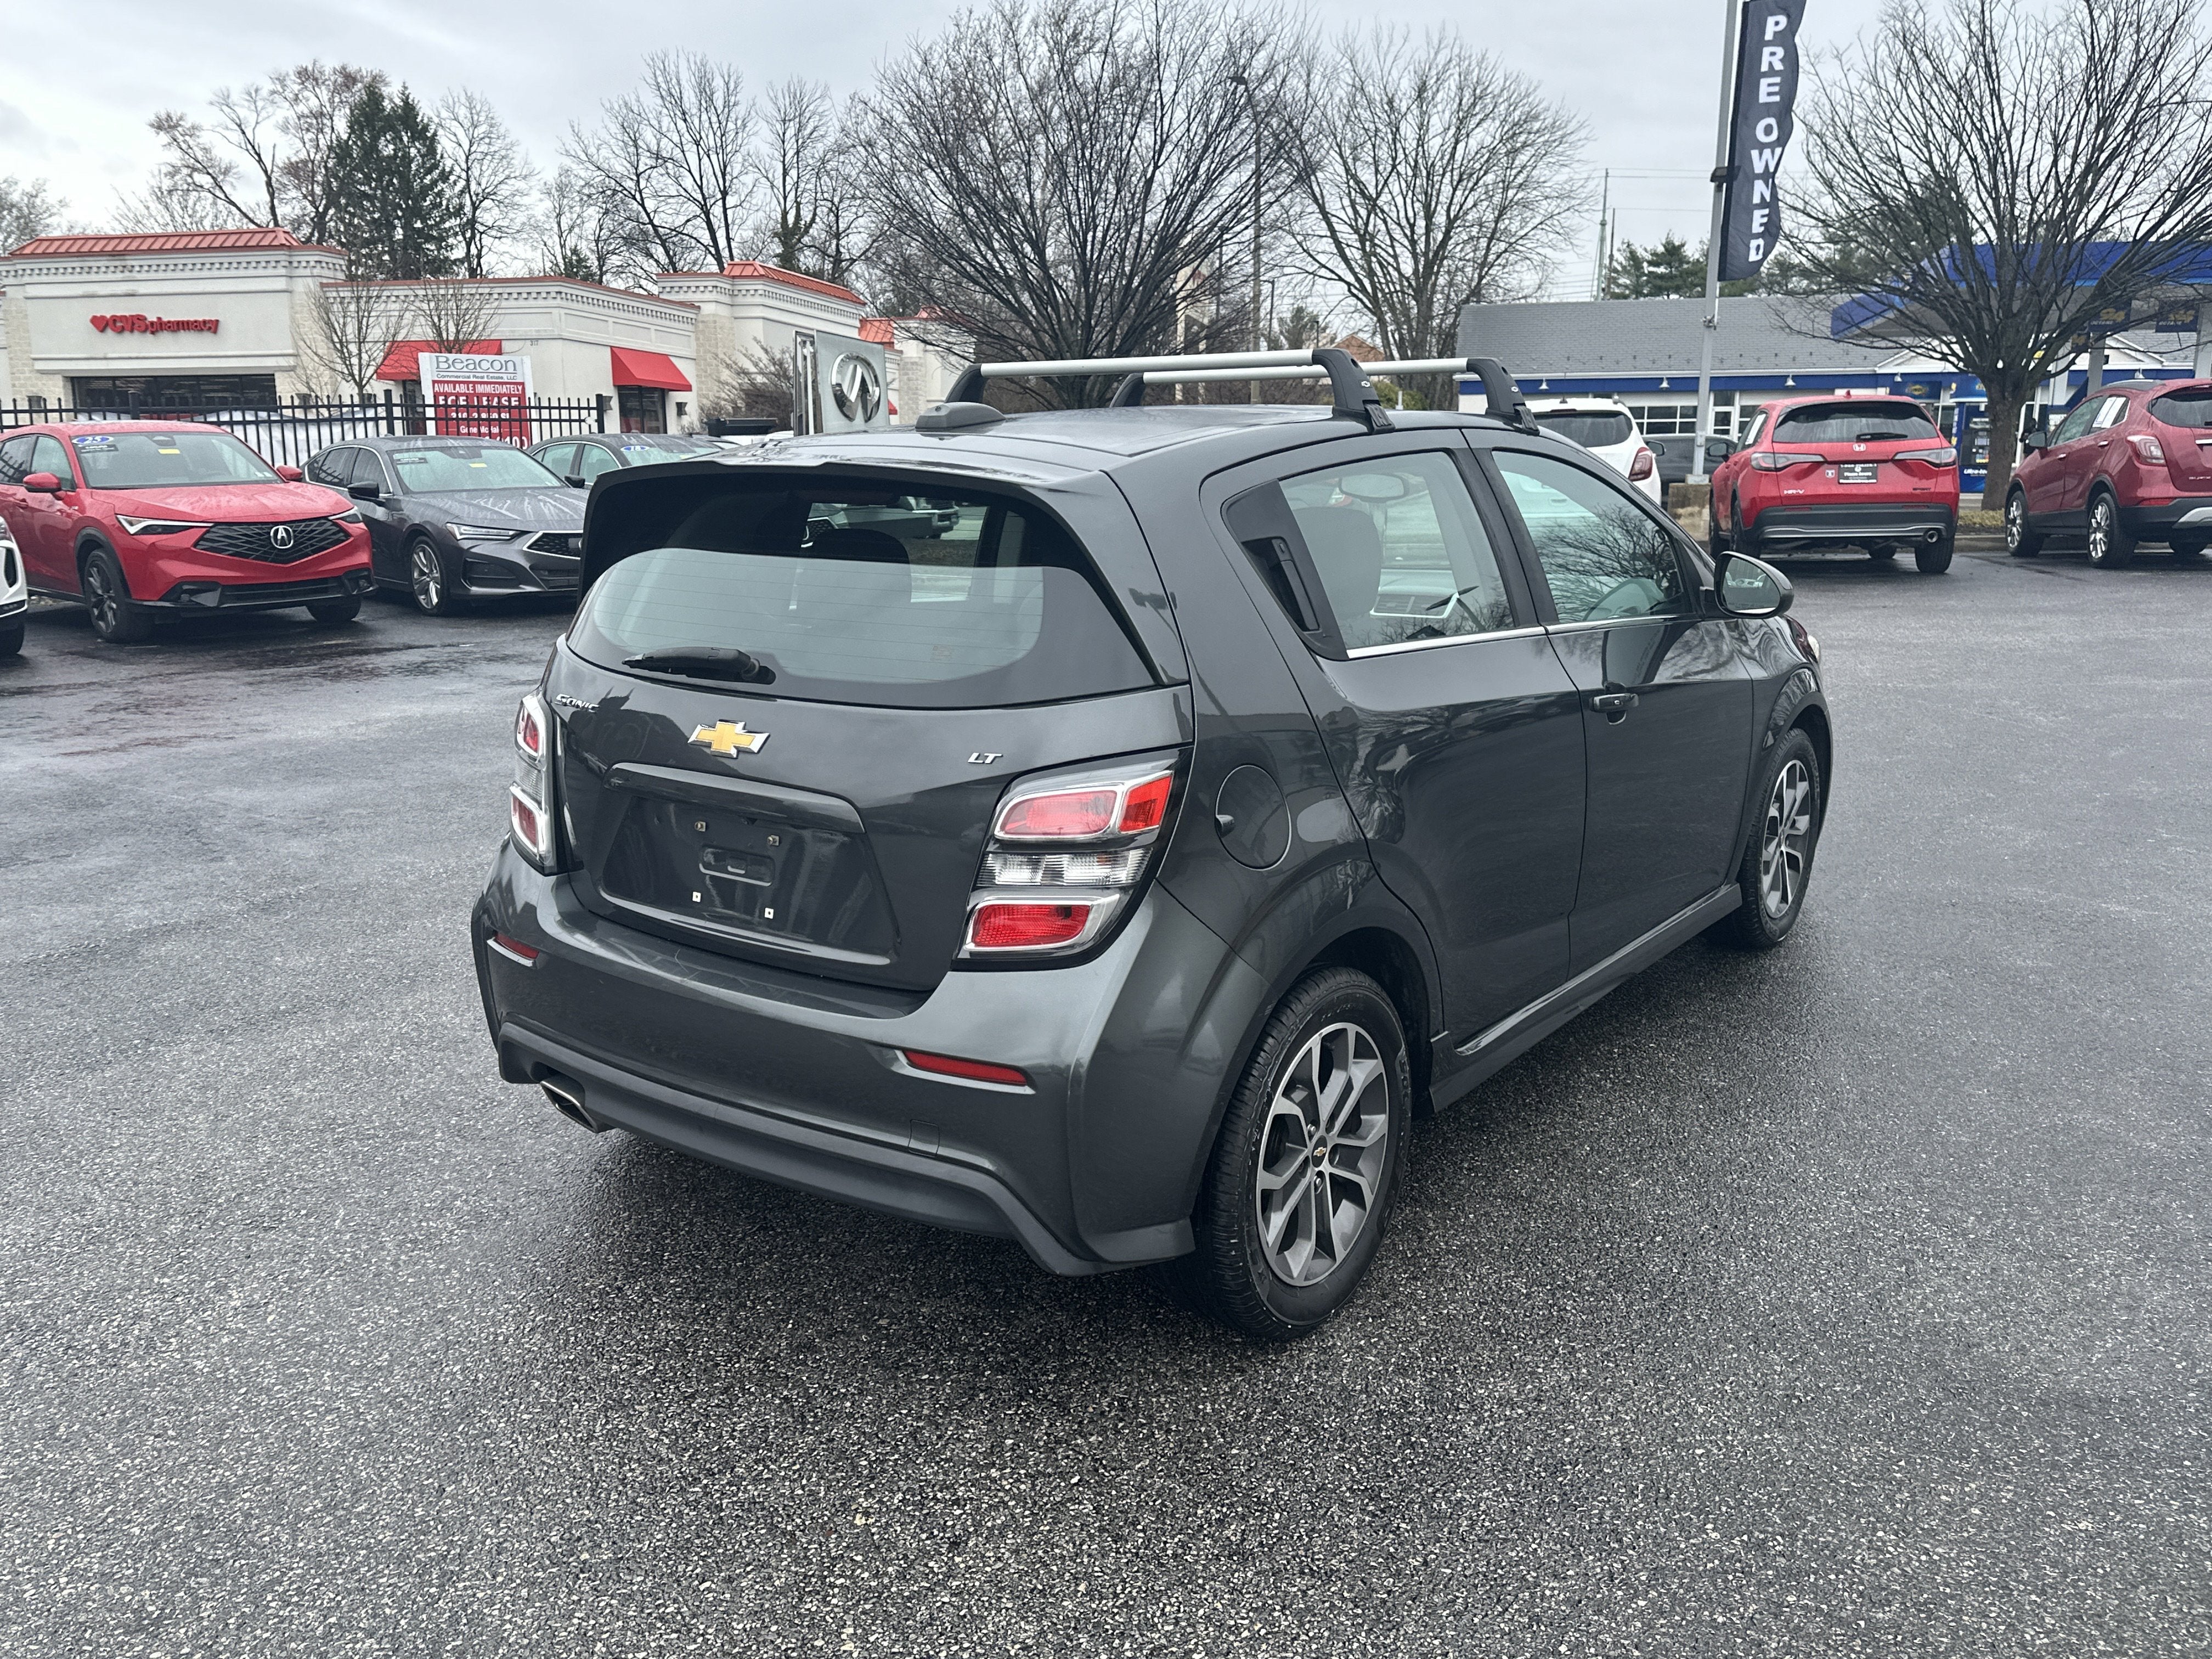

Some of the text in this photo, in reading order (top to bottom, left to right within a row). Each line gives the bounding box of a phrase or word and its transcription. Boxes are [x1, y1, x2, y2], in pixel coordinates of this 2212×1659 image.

[1748, 15, 1788, 262] PRE OWNED
[435, 356, 517, 372] Beacon
[434, 383, 523, 394] AVAILABLE IMMEDIATELY
[554, 693, 600, 713] SONIC
[967, 752, 1003, 764] LT
